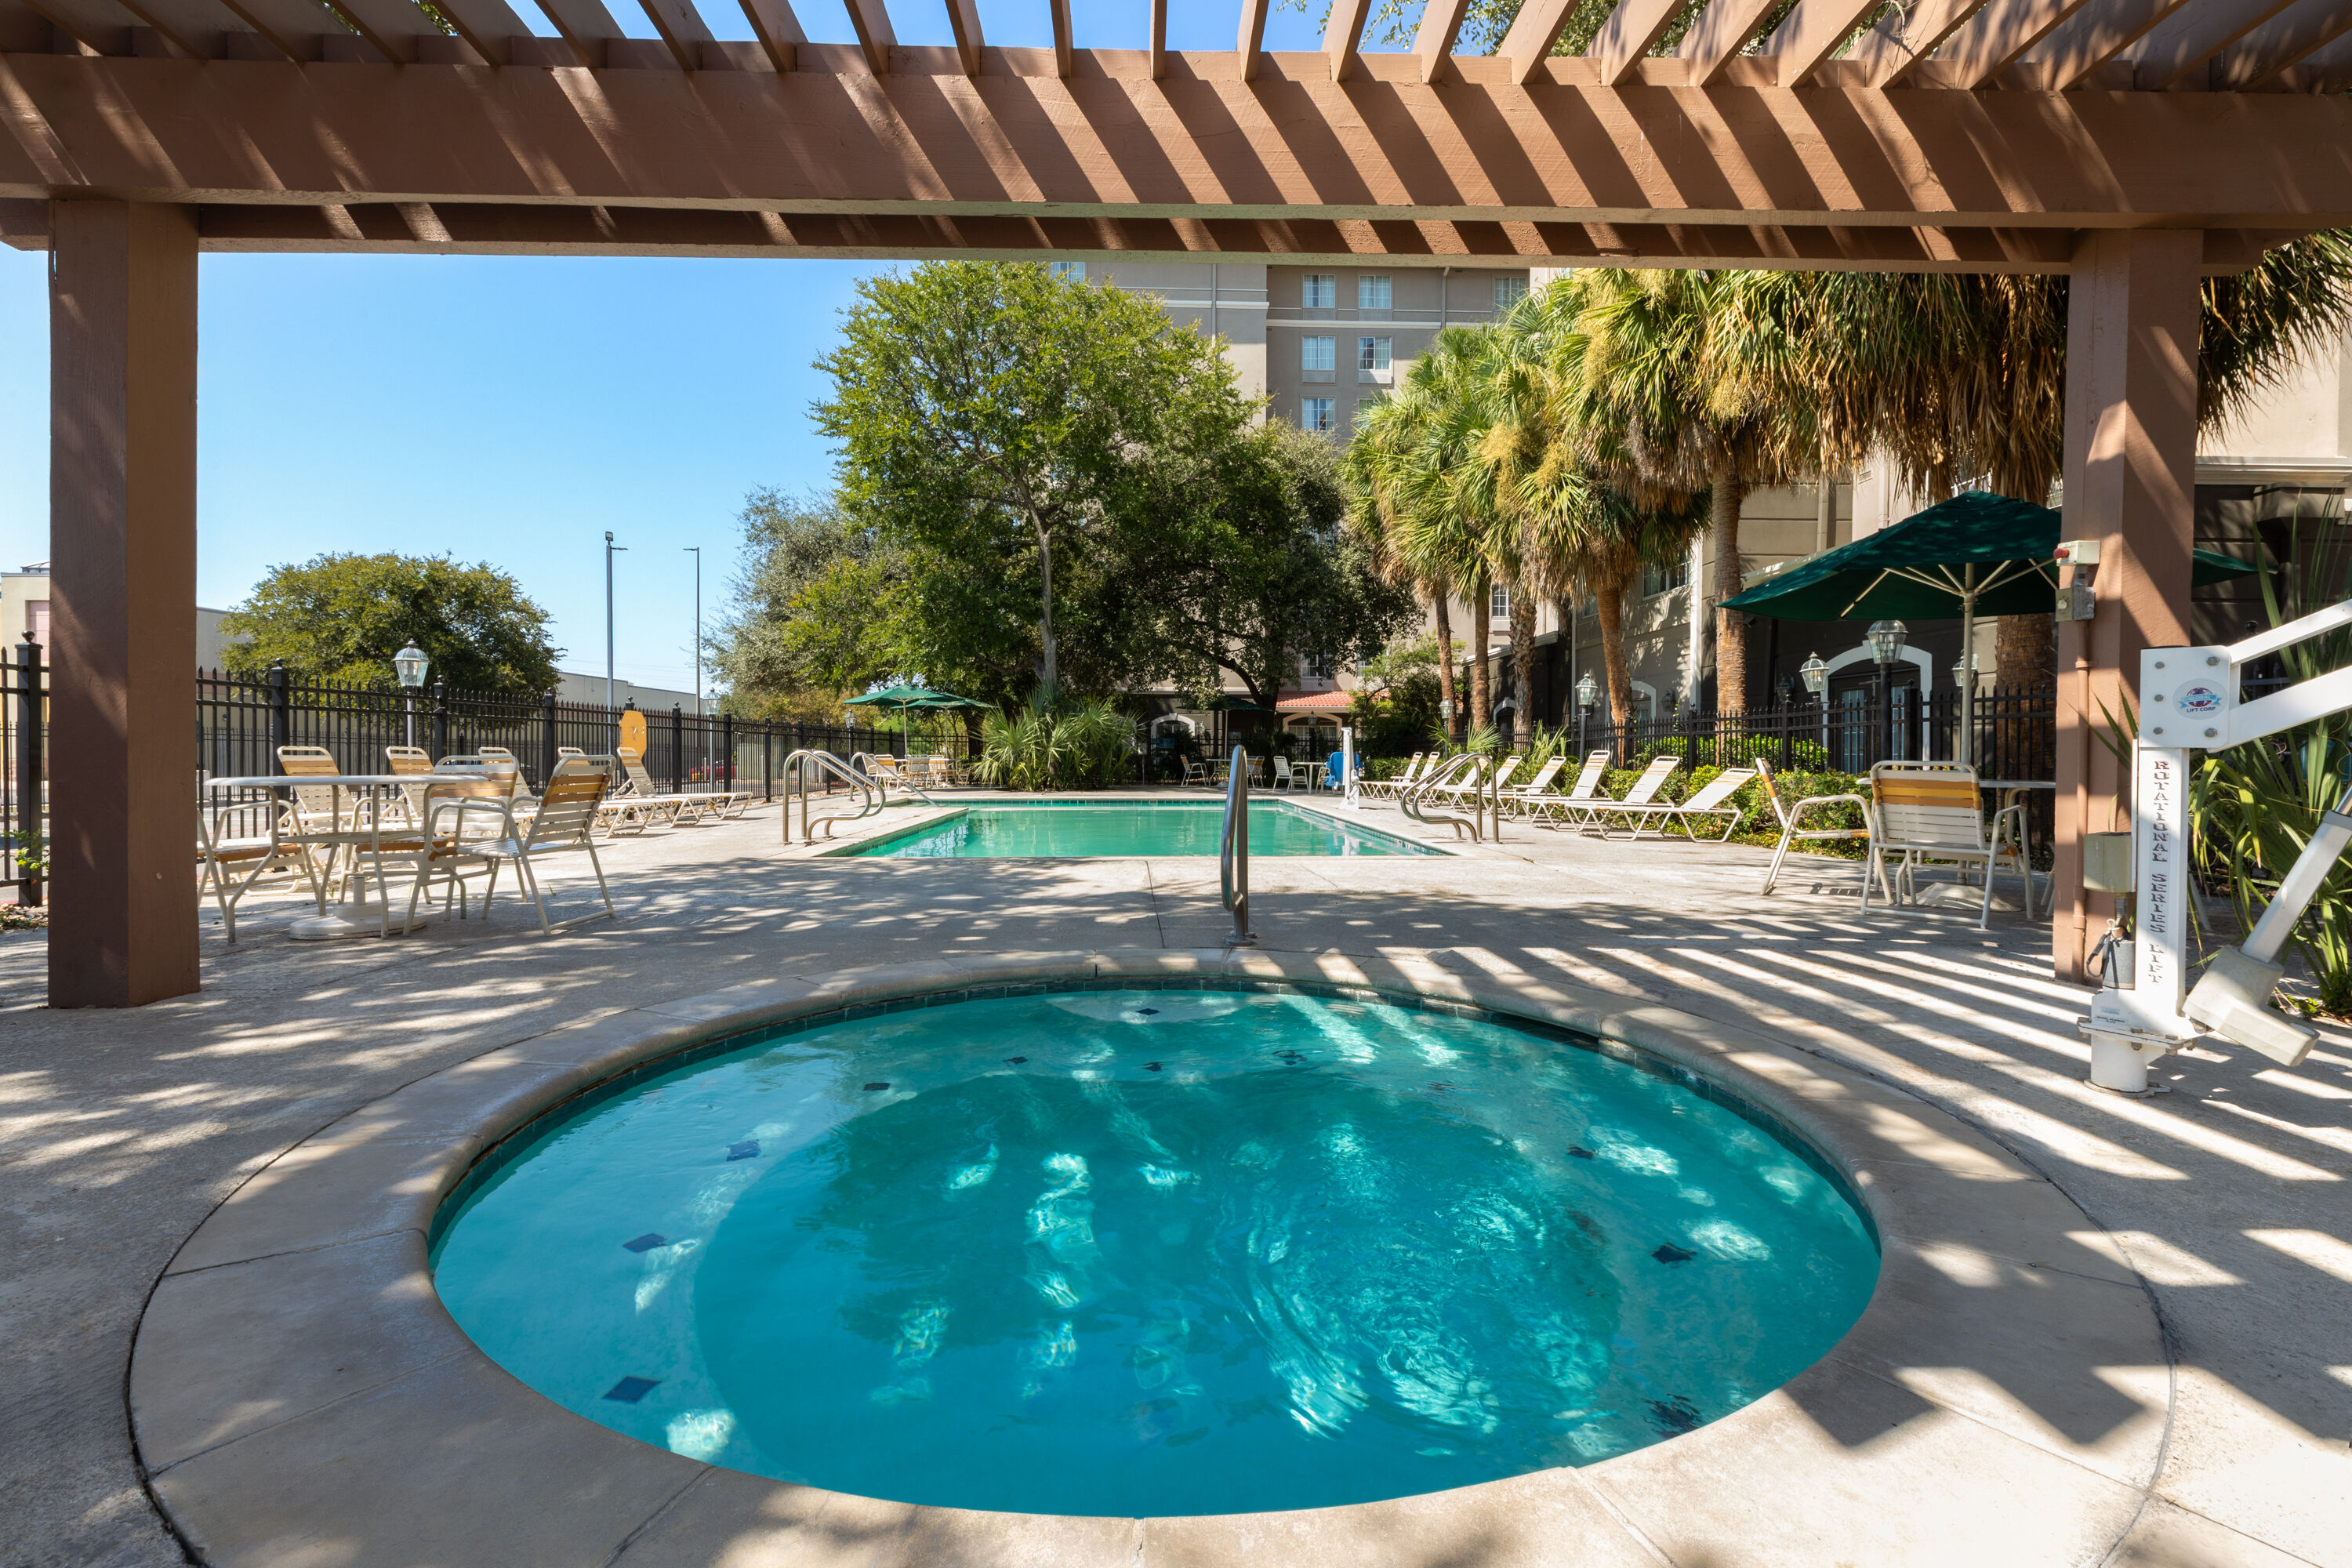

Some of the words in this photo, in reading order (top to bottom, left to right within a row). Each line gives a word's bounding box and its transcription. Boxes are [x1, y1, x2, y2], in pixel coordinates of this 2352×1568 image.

[2152, 760, 2169, 862] ROTATIONAL
[2150, 873, 2167, 933] SERIES
[2148, 943, 2164, 983] LIFT
